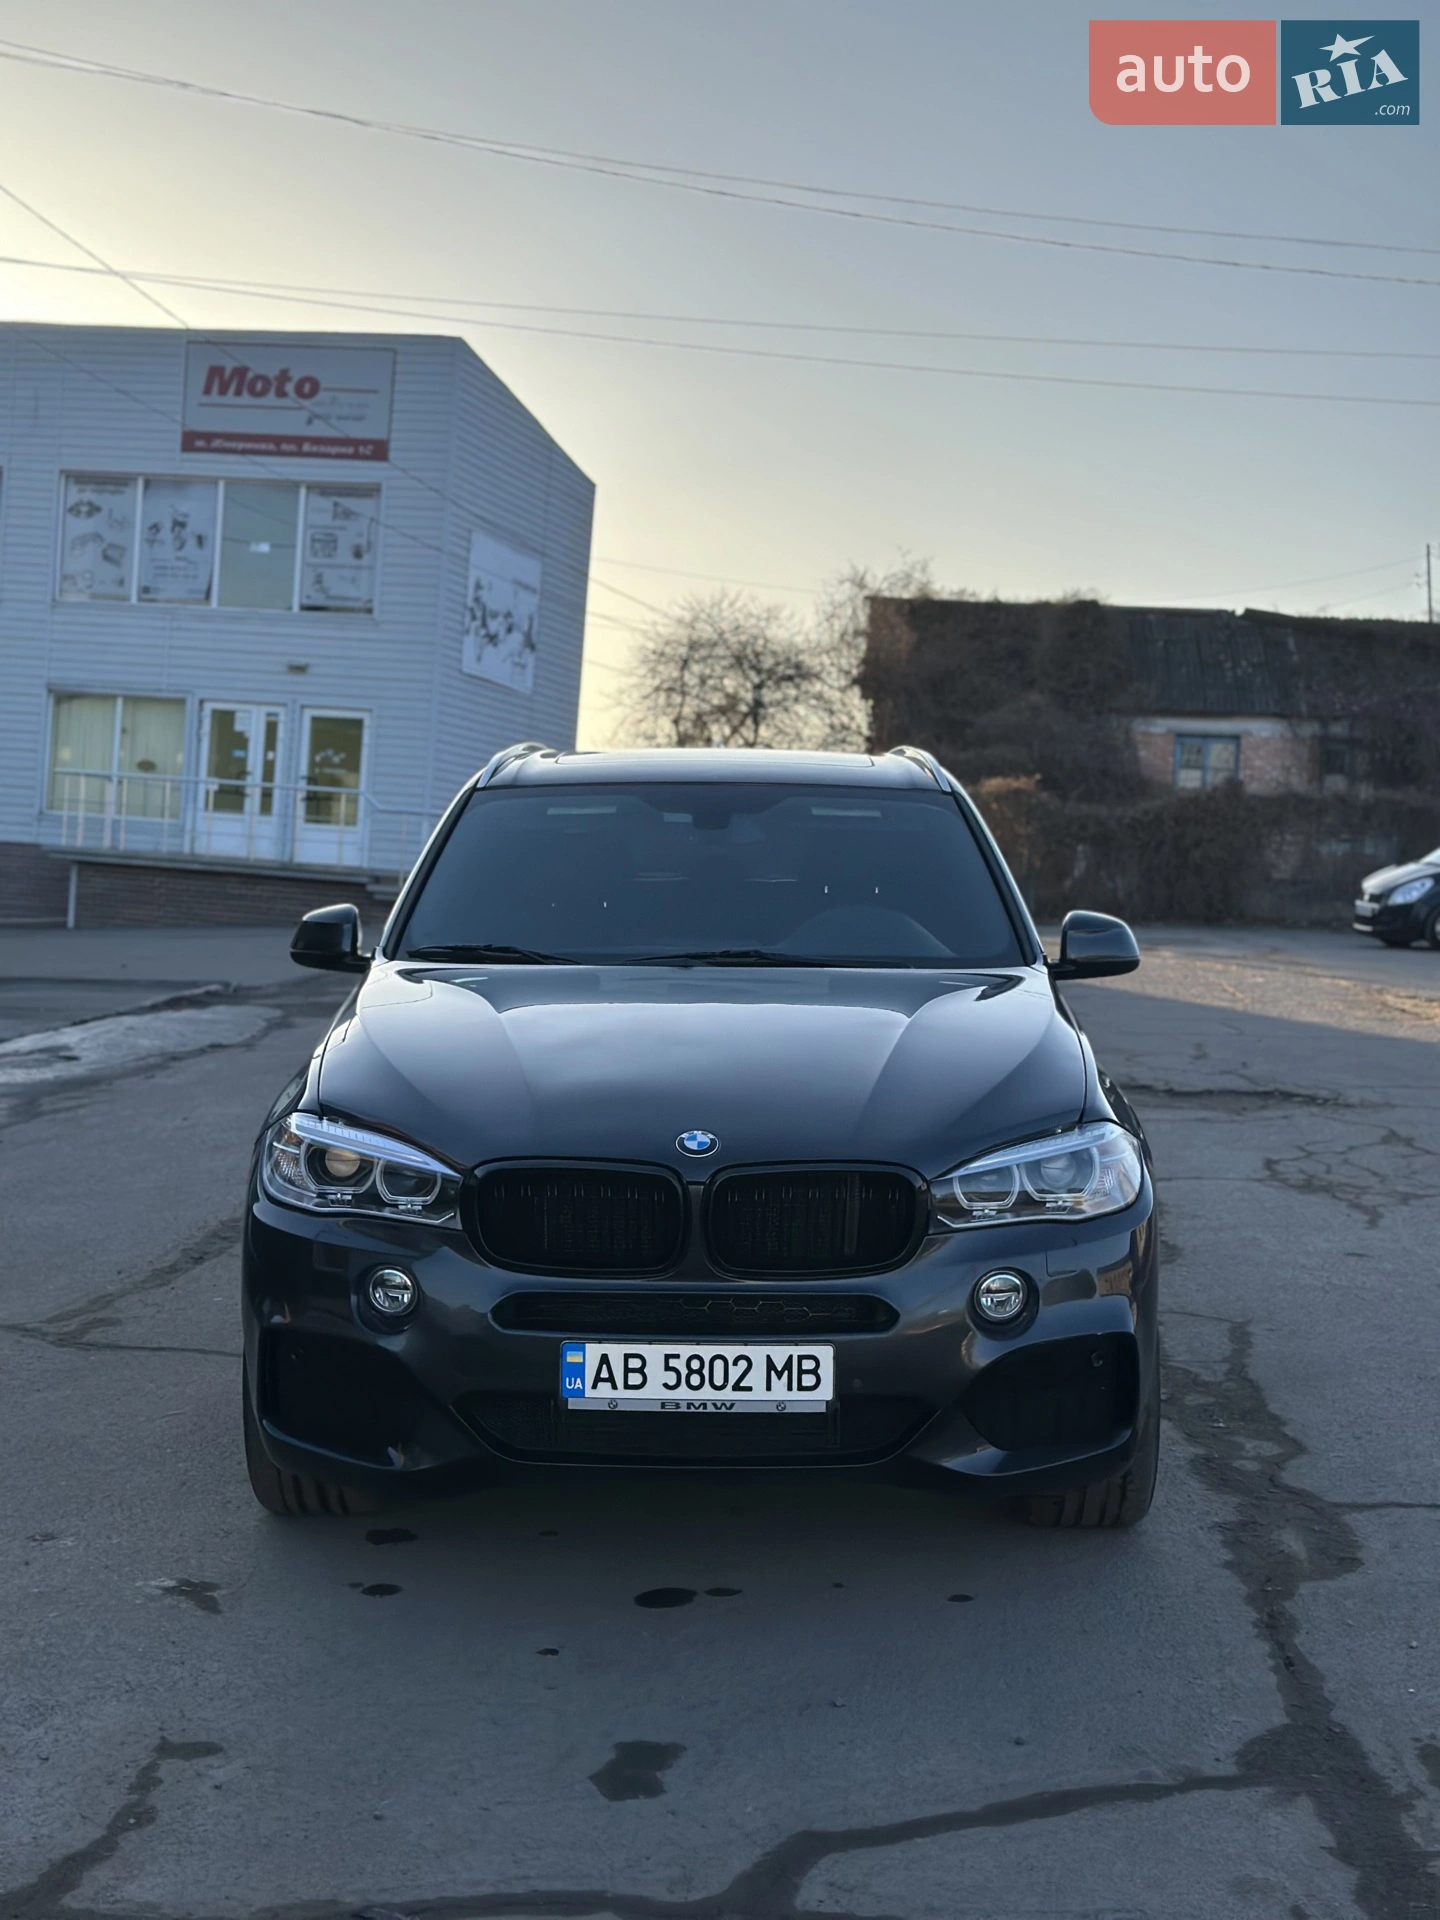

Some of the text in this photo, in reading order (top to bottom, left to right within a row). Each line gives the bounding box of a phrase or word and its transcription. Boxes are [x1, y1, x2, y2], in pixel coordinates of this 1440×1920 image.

[203, 364, 321, 400] Moto
[565, 1353, 822, 1392] UA AB 5802 MB
[660, 1401, 736, 1411] BMW
